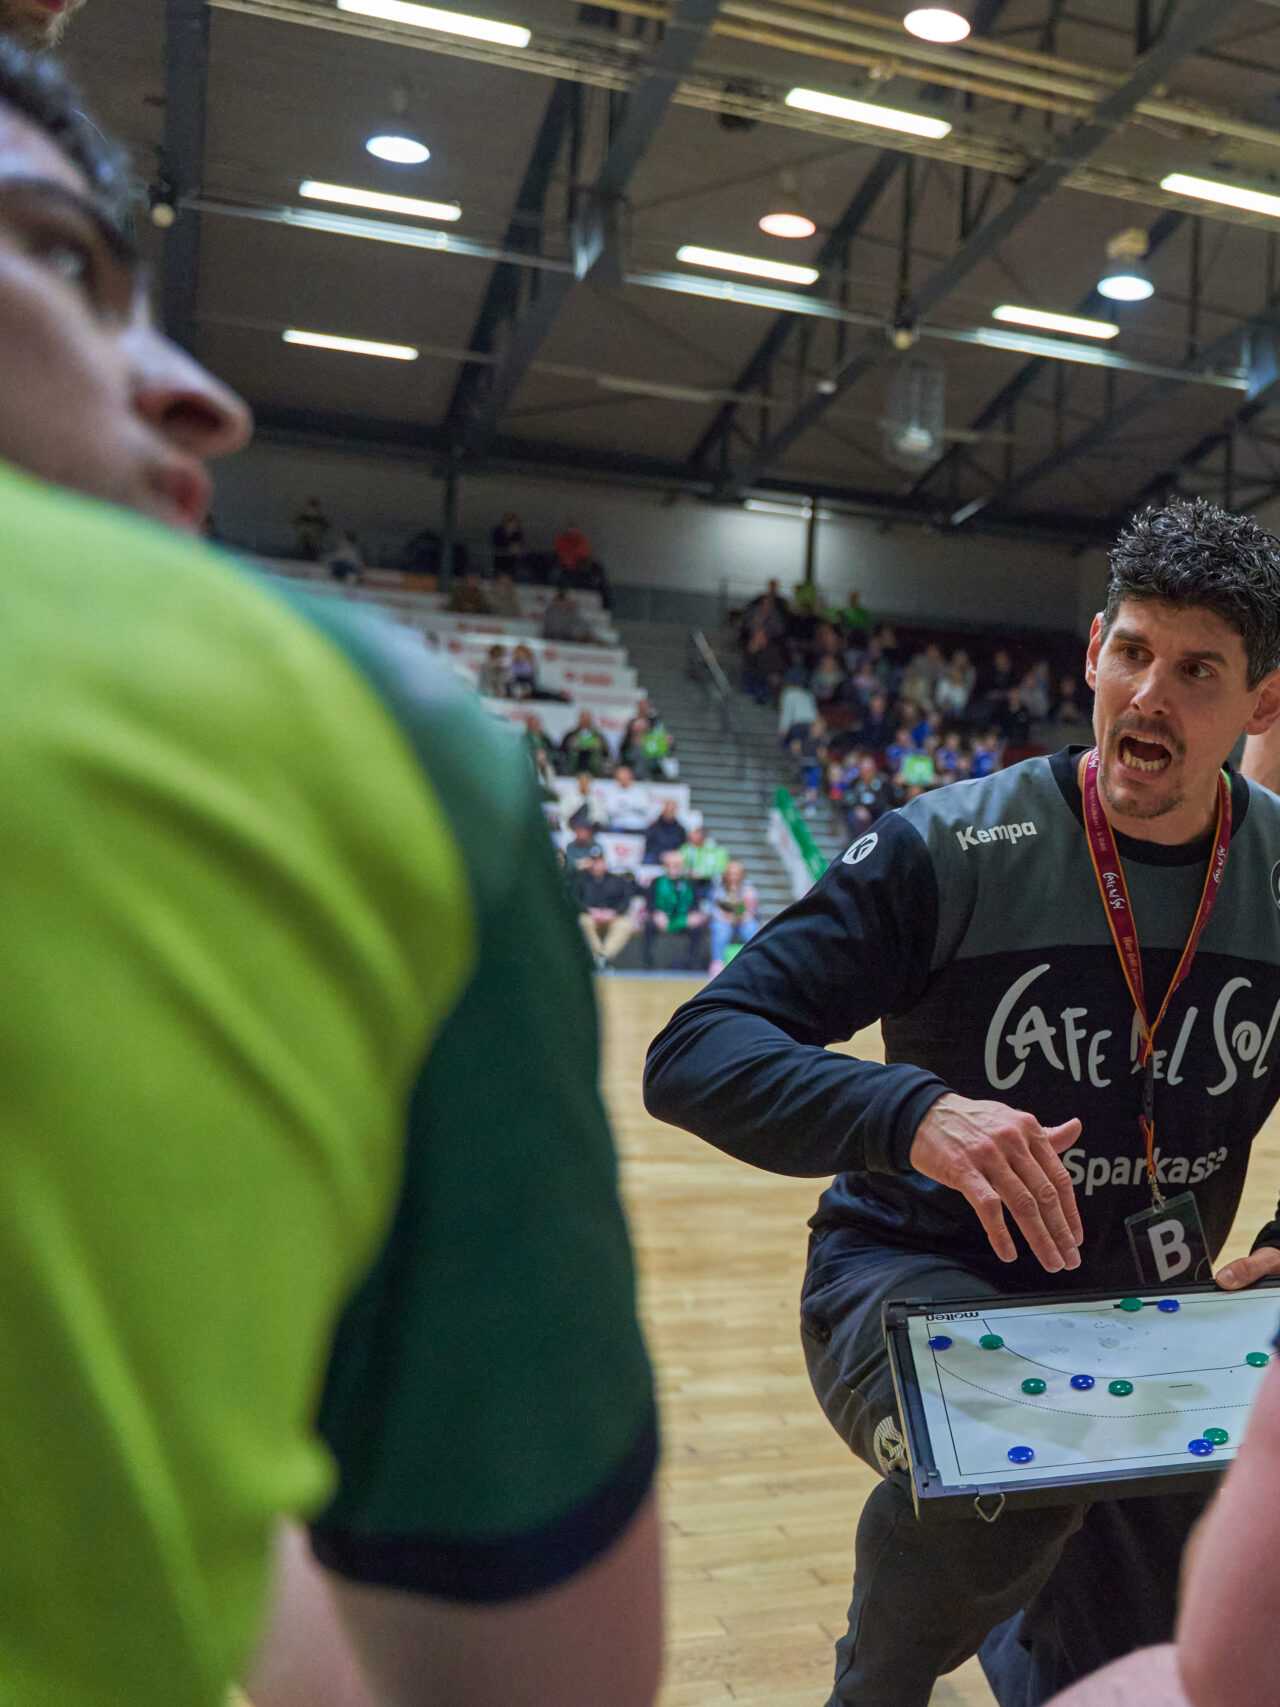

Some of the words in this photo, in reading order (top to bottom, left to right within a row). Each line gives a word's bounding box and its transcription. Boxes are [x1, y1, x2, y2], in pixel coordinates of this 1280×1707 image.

[956, 821, 1038, 851] Kempa
[1147, 1219, 1192, 1282] B
[925, 1311, 979, 1322] molten
